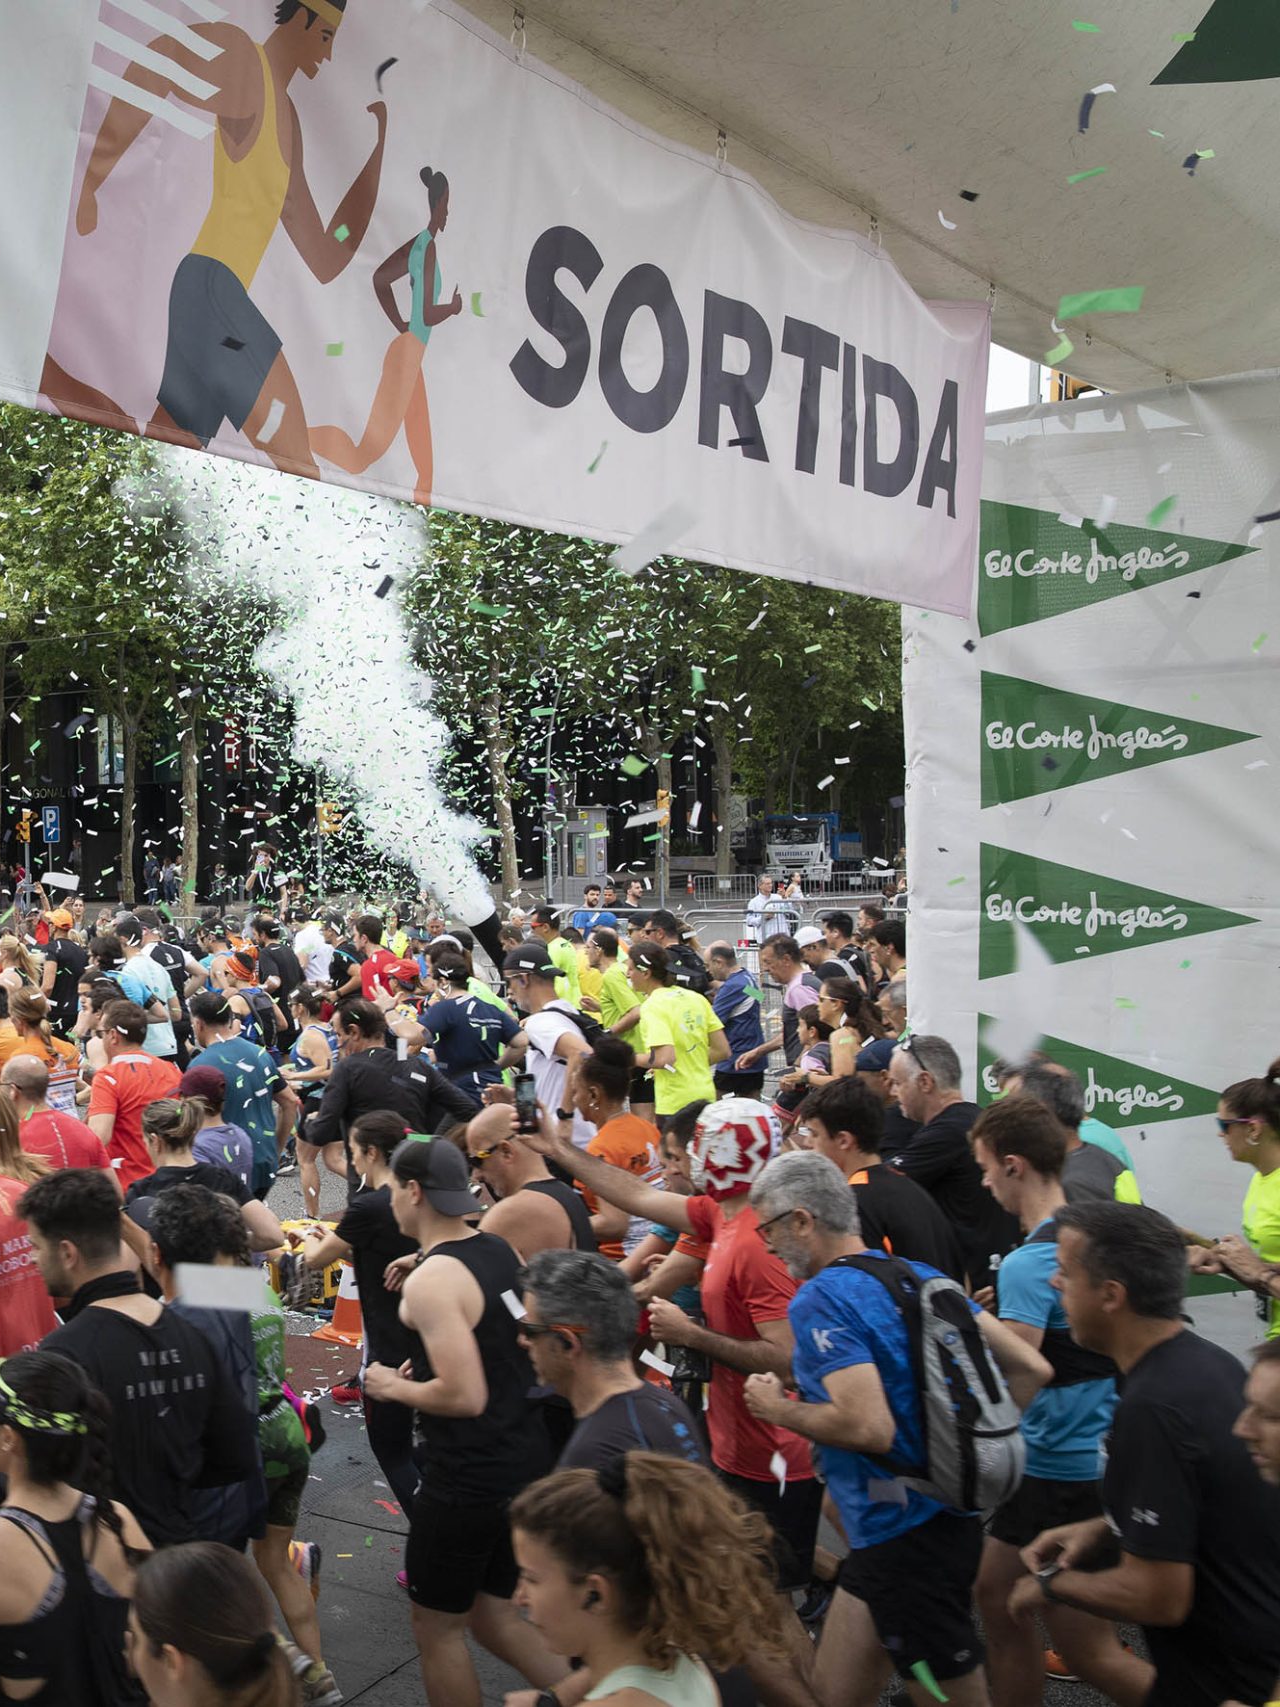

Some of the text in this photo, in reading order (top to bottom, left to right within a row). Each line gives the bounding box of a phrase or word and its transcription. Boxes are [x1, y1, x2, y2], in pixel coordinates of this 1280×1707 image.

[509, 225, 958, 519] SORTIDA
[984, 538, 1189, 584] El Corte Inglés
[985, 714, 1188, 760] El Corte Inglés
[46, 810, 56, 828] P
[985, 891, 1188, 937] El Corte Inglés
[982, 1065, 1184, 1116] E Inglés
[3, 1235, 32, 1255] MAK
